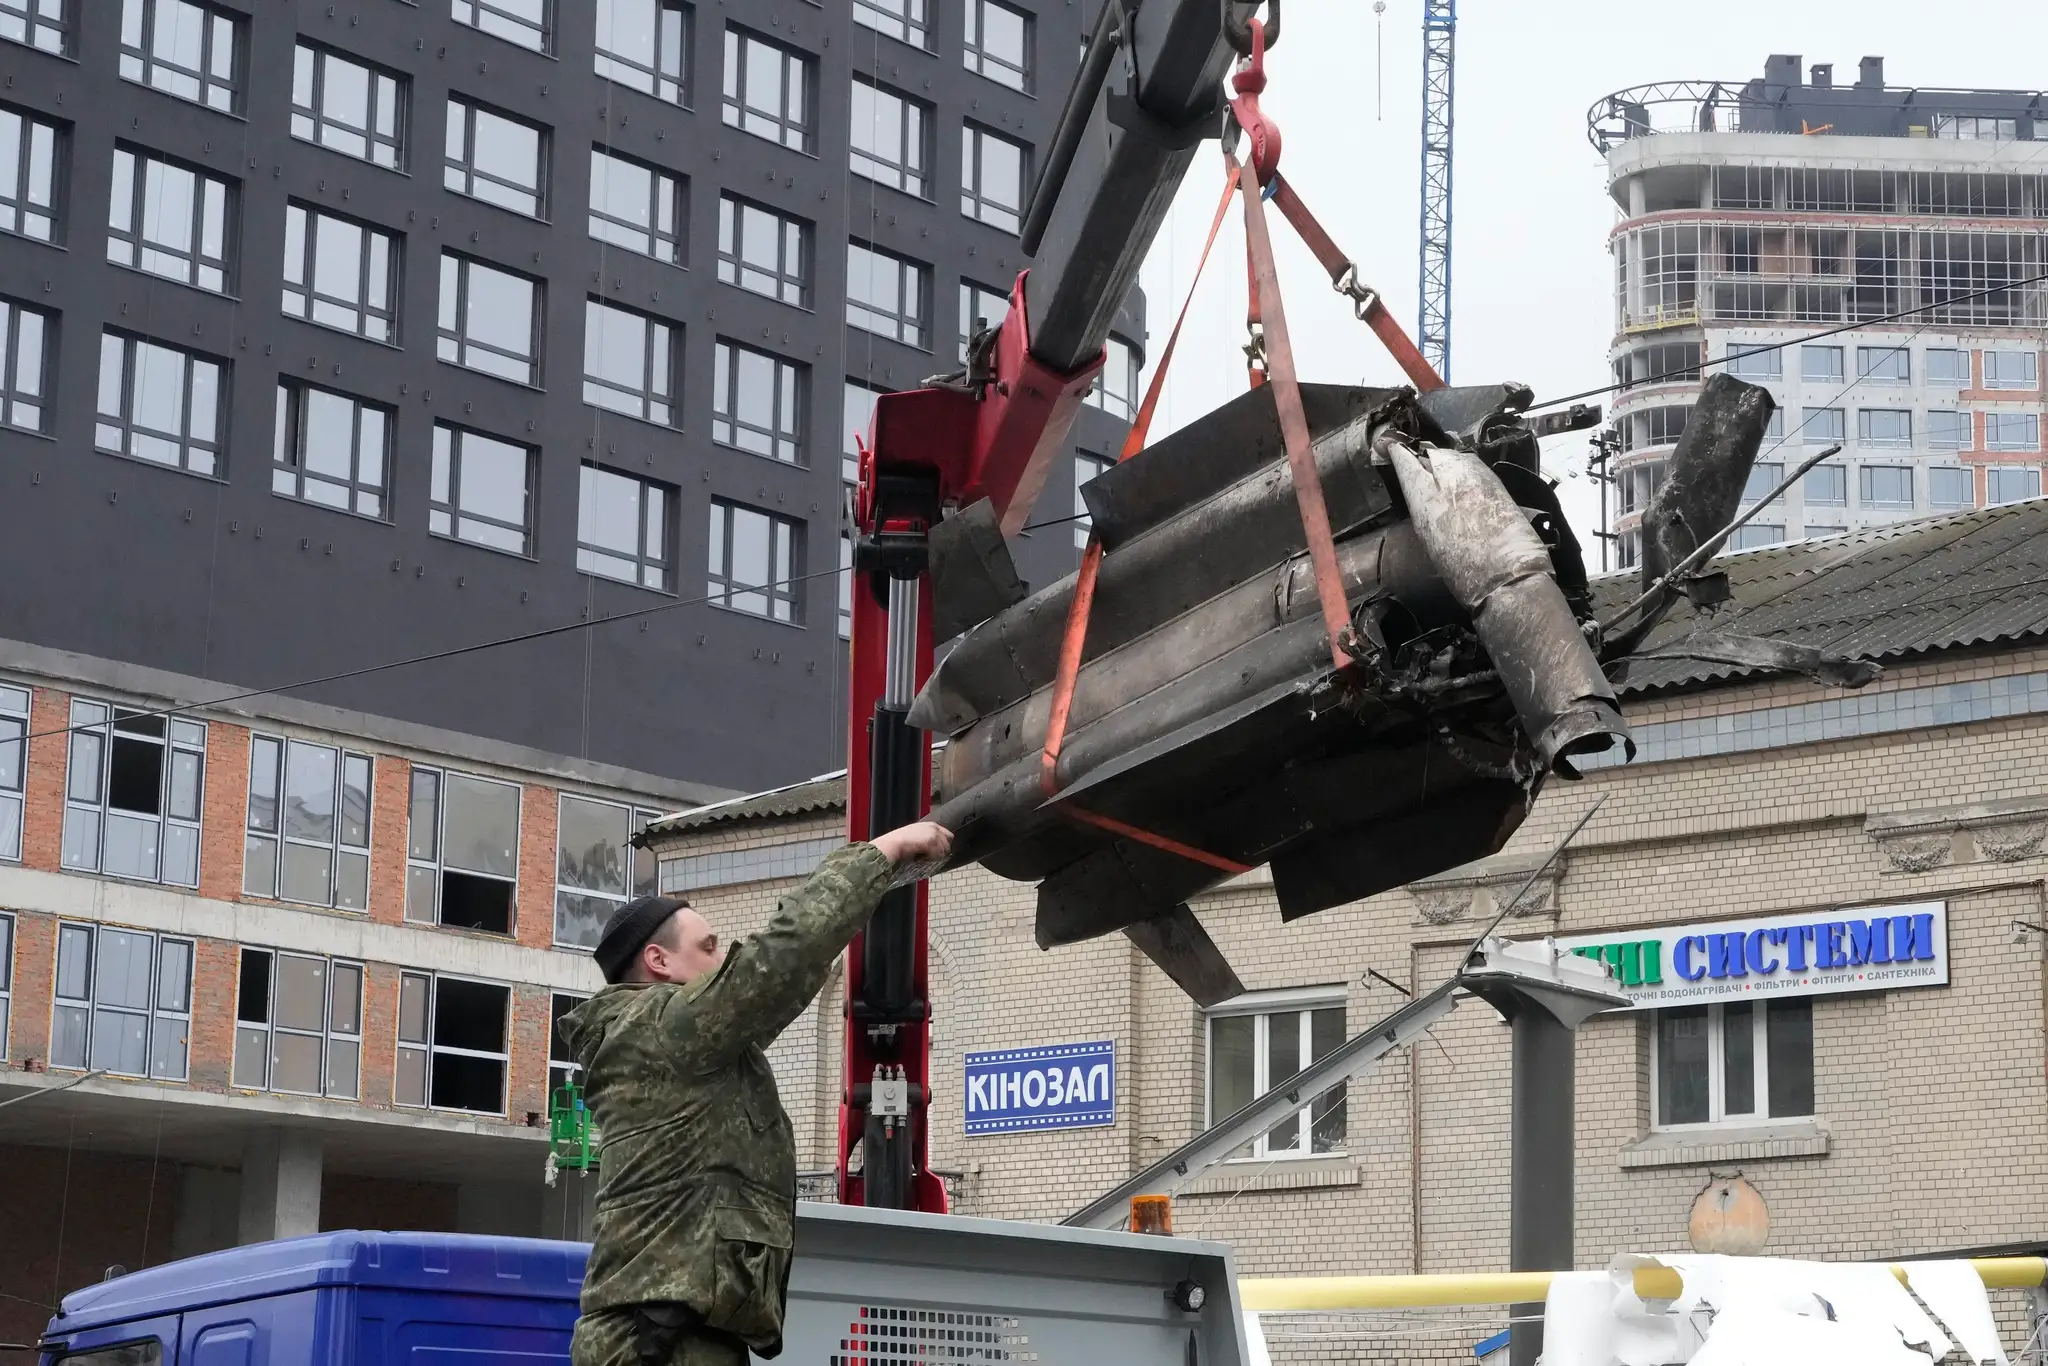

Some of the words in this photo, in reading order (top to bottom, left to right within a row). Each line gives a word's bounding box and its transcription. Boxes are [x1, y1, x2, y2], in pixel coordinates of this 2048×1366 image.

[1672, 913, 1936, 982] СИСТЕМИ
[1660, 984, 1743, 1000] ВОДОНАГРІВАЧІ
[1753, 979, 1801, 992] ФІЛЬТРИ
[1811, 974, 1856, 986] ФІТІНГИ
[1867, 967, 1937, 982] САНТЕХНІКА
[968, 1063, 1109, 1112] КІНОЗАЛ
